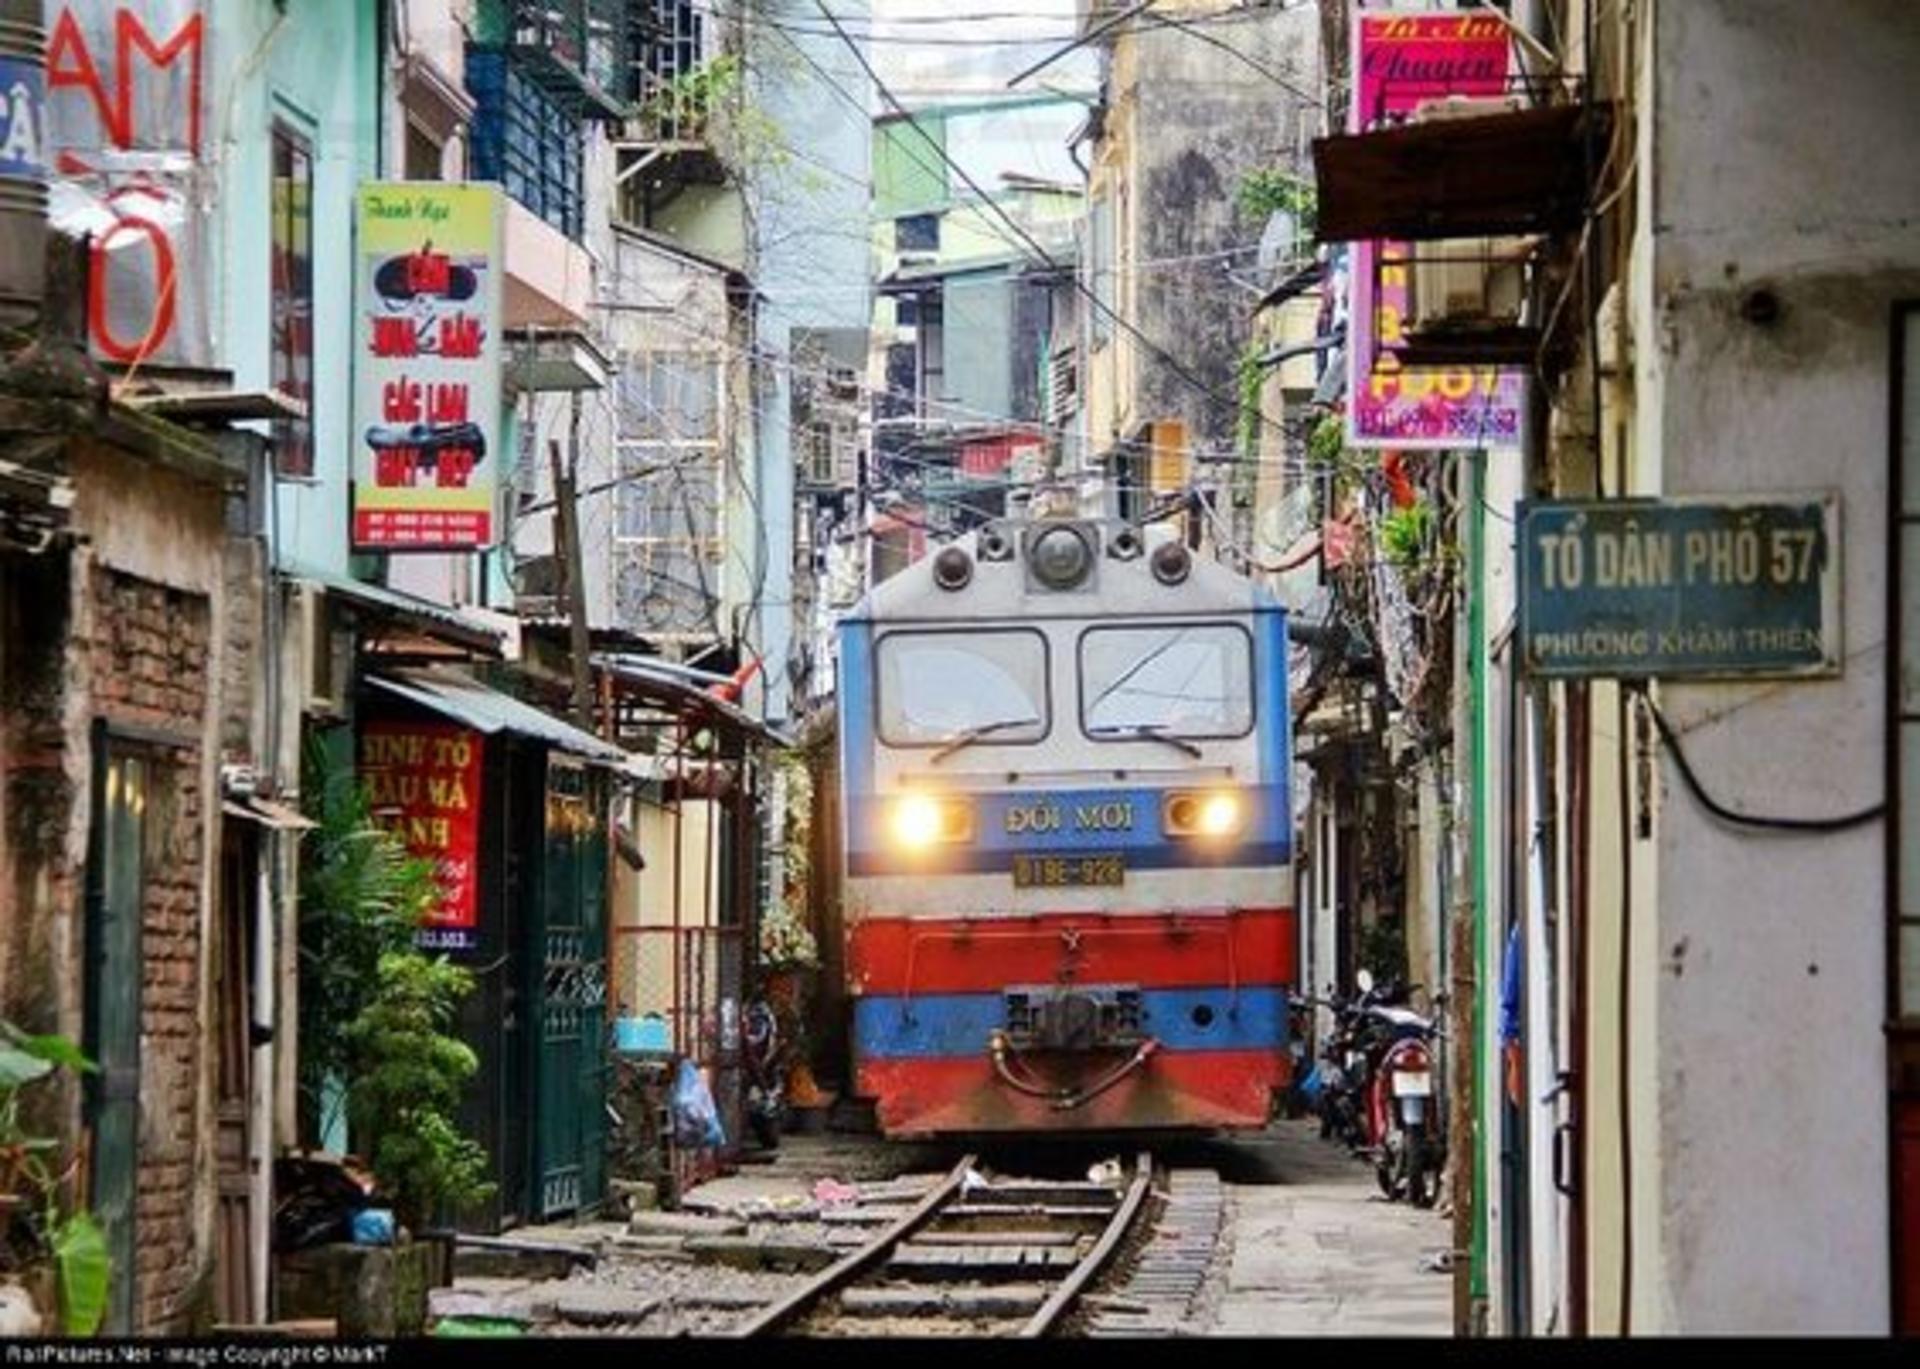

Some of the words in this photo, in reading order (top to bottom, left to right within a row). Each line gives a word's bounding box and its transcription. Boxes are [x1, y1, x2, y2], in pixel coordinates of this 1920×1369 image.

[1595, 519, 1673, 588] DÂN
[1685, 512, 1758, 585] PHỐ
[1771, 529, 1816, 585] 57
